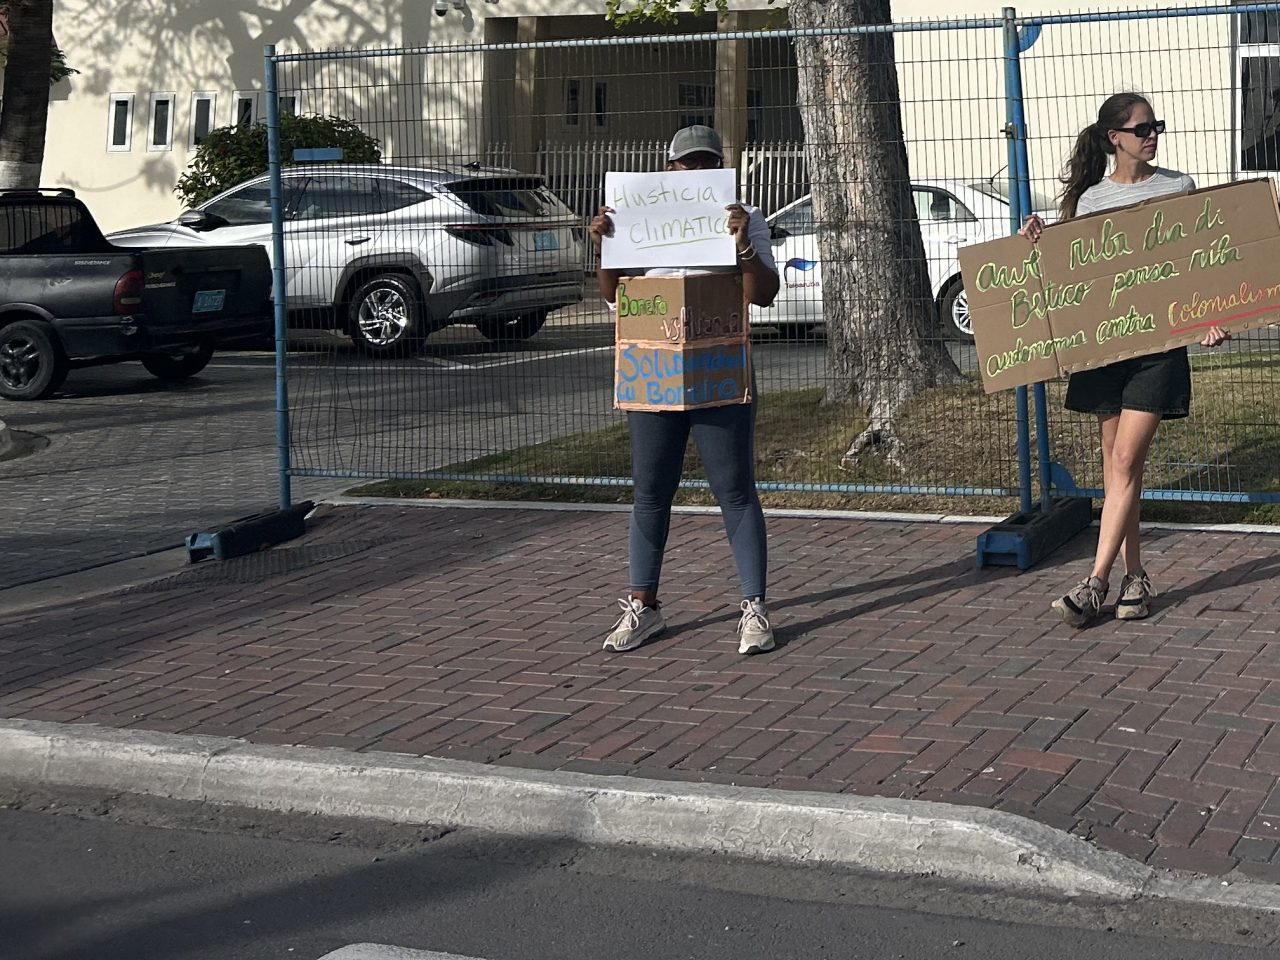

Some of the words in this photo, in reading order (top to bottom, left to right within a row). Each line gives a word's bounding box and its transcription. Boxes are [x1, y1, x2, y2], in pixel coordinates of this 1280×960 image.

[613, 181, 718, 209] Husticia
[1194, 196, 1225, 234] di
[1011, 280, 1096, 329] Betico
